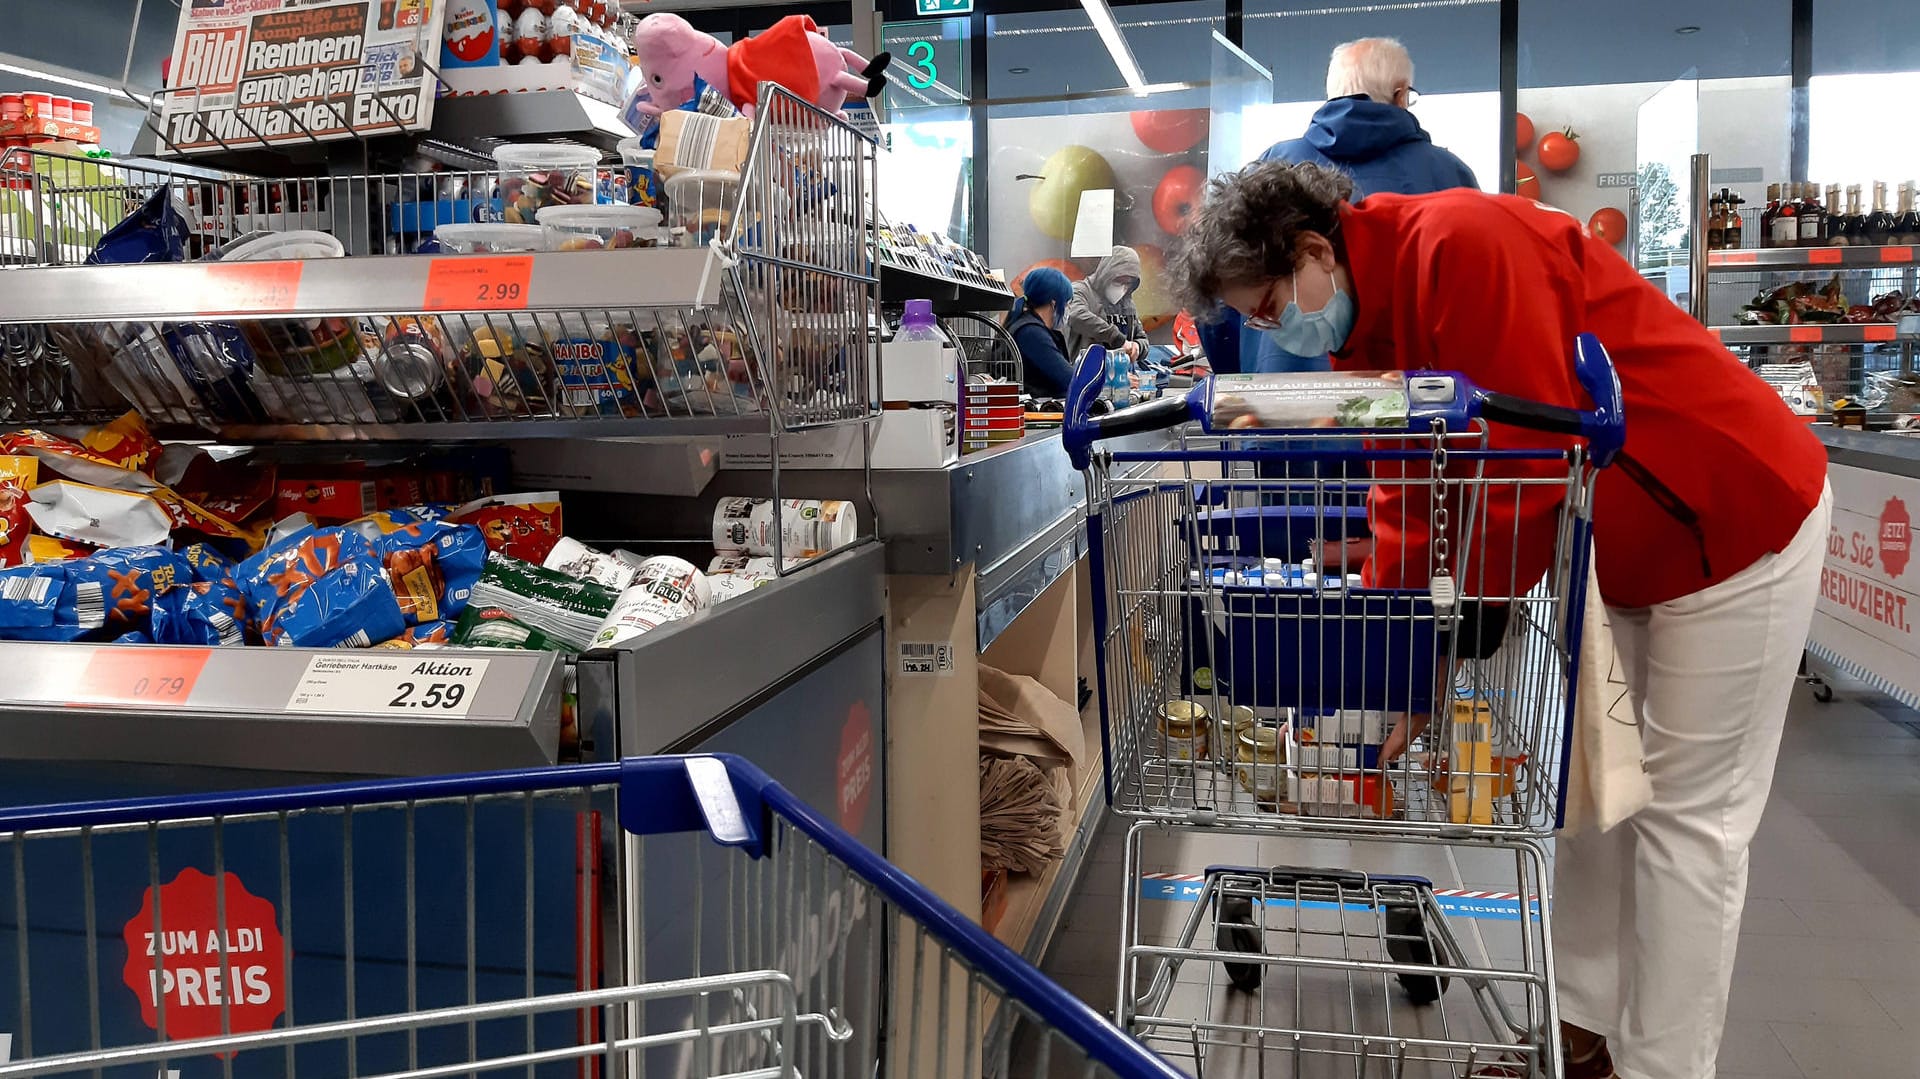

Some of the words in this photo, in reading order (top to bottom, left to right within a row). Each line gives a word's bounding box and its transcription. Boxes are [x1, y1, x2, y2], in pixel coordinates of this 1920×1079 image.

[261, 8, 333, 27] Anträge
[338, 7, 359, 19] zu
[182, 30, 244, 87] Bild
[247, 34, 362, 71] Rentnern
[366, 51, 399, 64] Flick
[908, 40, 938, 89] 3
[240, 67, 357, 106] entgehen
[171, 113, 197, 145] 10
[206, 100, 347, 142] Milliarden
[352, 92, 418, 127] Euro
[1600, 174, 1635, 186] FRISC
[477, 283, 520, 300] 2.99
[1313, 381, 1340, 389] DER
[1345, 380, 1387, 388] SPUR.
[322, 485, 336, 497] STIX
[1828, 525, 1847, 559] ür
[1850, 531, 1874, 568] Sie
[647, 581, 681, 603] IALIA
[1820, 566, 1911, 634] REDUZIERT.
[315, 661, 360, 670] Geriebener
[361, 663, 398, 671] Hartkäse
[411, 661, 473, 676] Aktion
[133, 677, 184, 696] 0.79
[388, 682, 466, 709] 2.59
[843, 754, 871, 813] PREIS
[1161, 885, 1175, 894] 2
[144, 930, 199, 956] ZUM
[206, 927, 263, 954] ALDI
[149, 965, 272, 1007] PREIS
